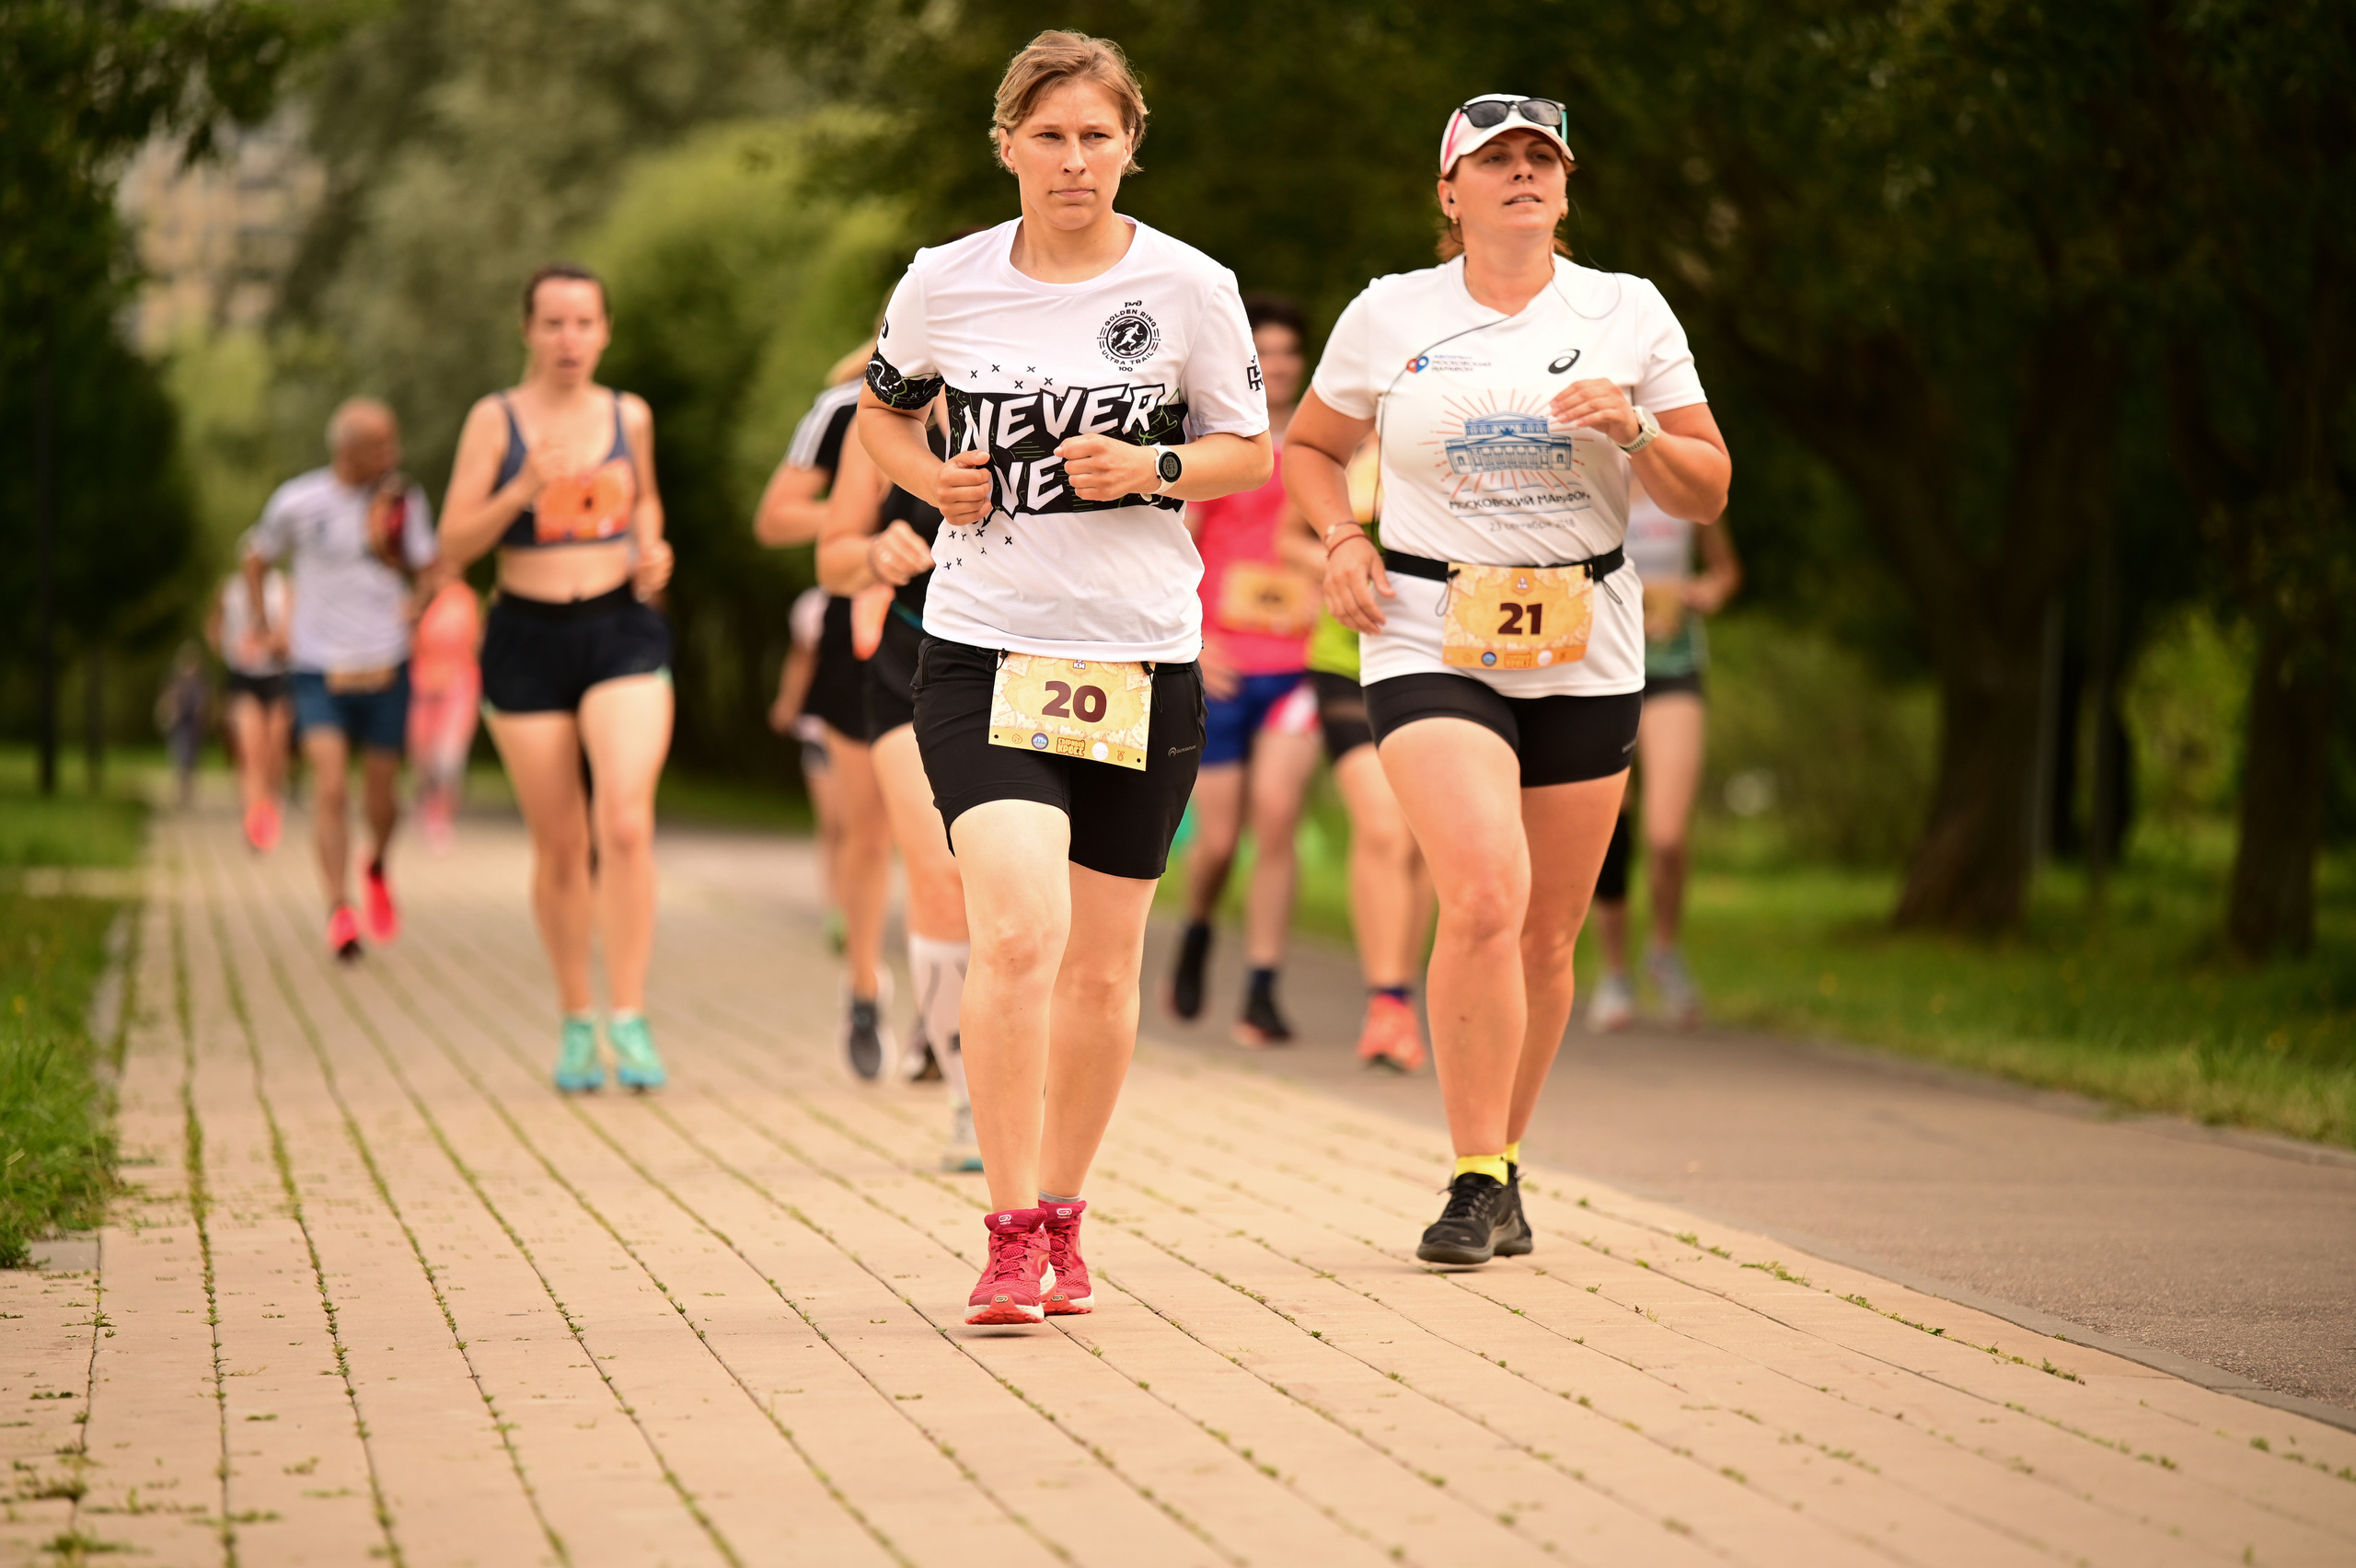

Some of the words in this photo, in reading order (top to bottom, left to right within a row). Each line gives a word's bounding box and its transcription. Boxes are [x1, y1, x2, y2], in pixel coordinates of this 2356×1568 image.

[1104, 309, 1138, 327] GOLDEN
[1139, 311, 1157, 328] RING
[1102, 350, 1126, 365] ULTRA
[1129, 352, 1154, 365] TRAIL
[960, 383, 1165, 452] NEVER
[1497, 603, 1542, 635] 21
[1042, 680, 1107, 722] 20
